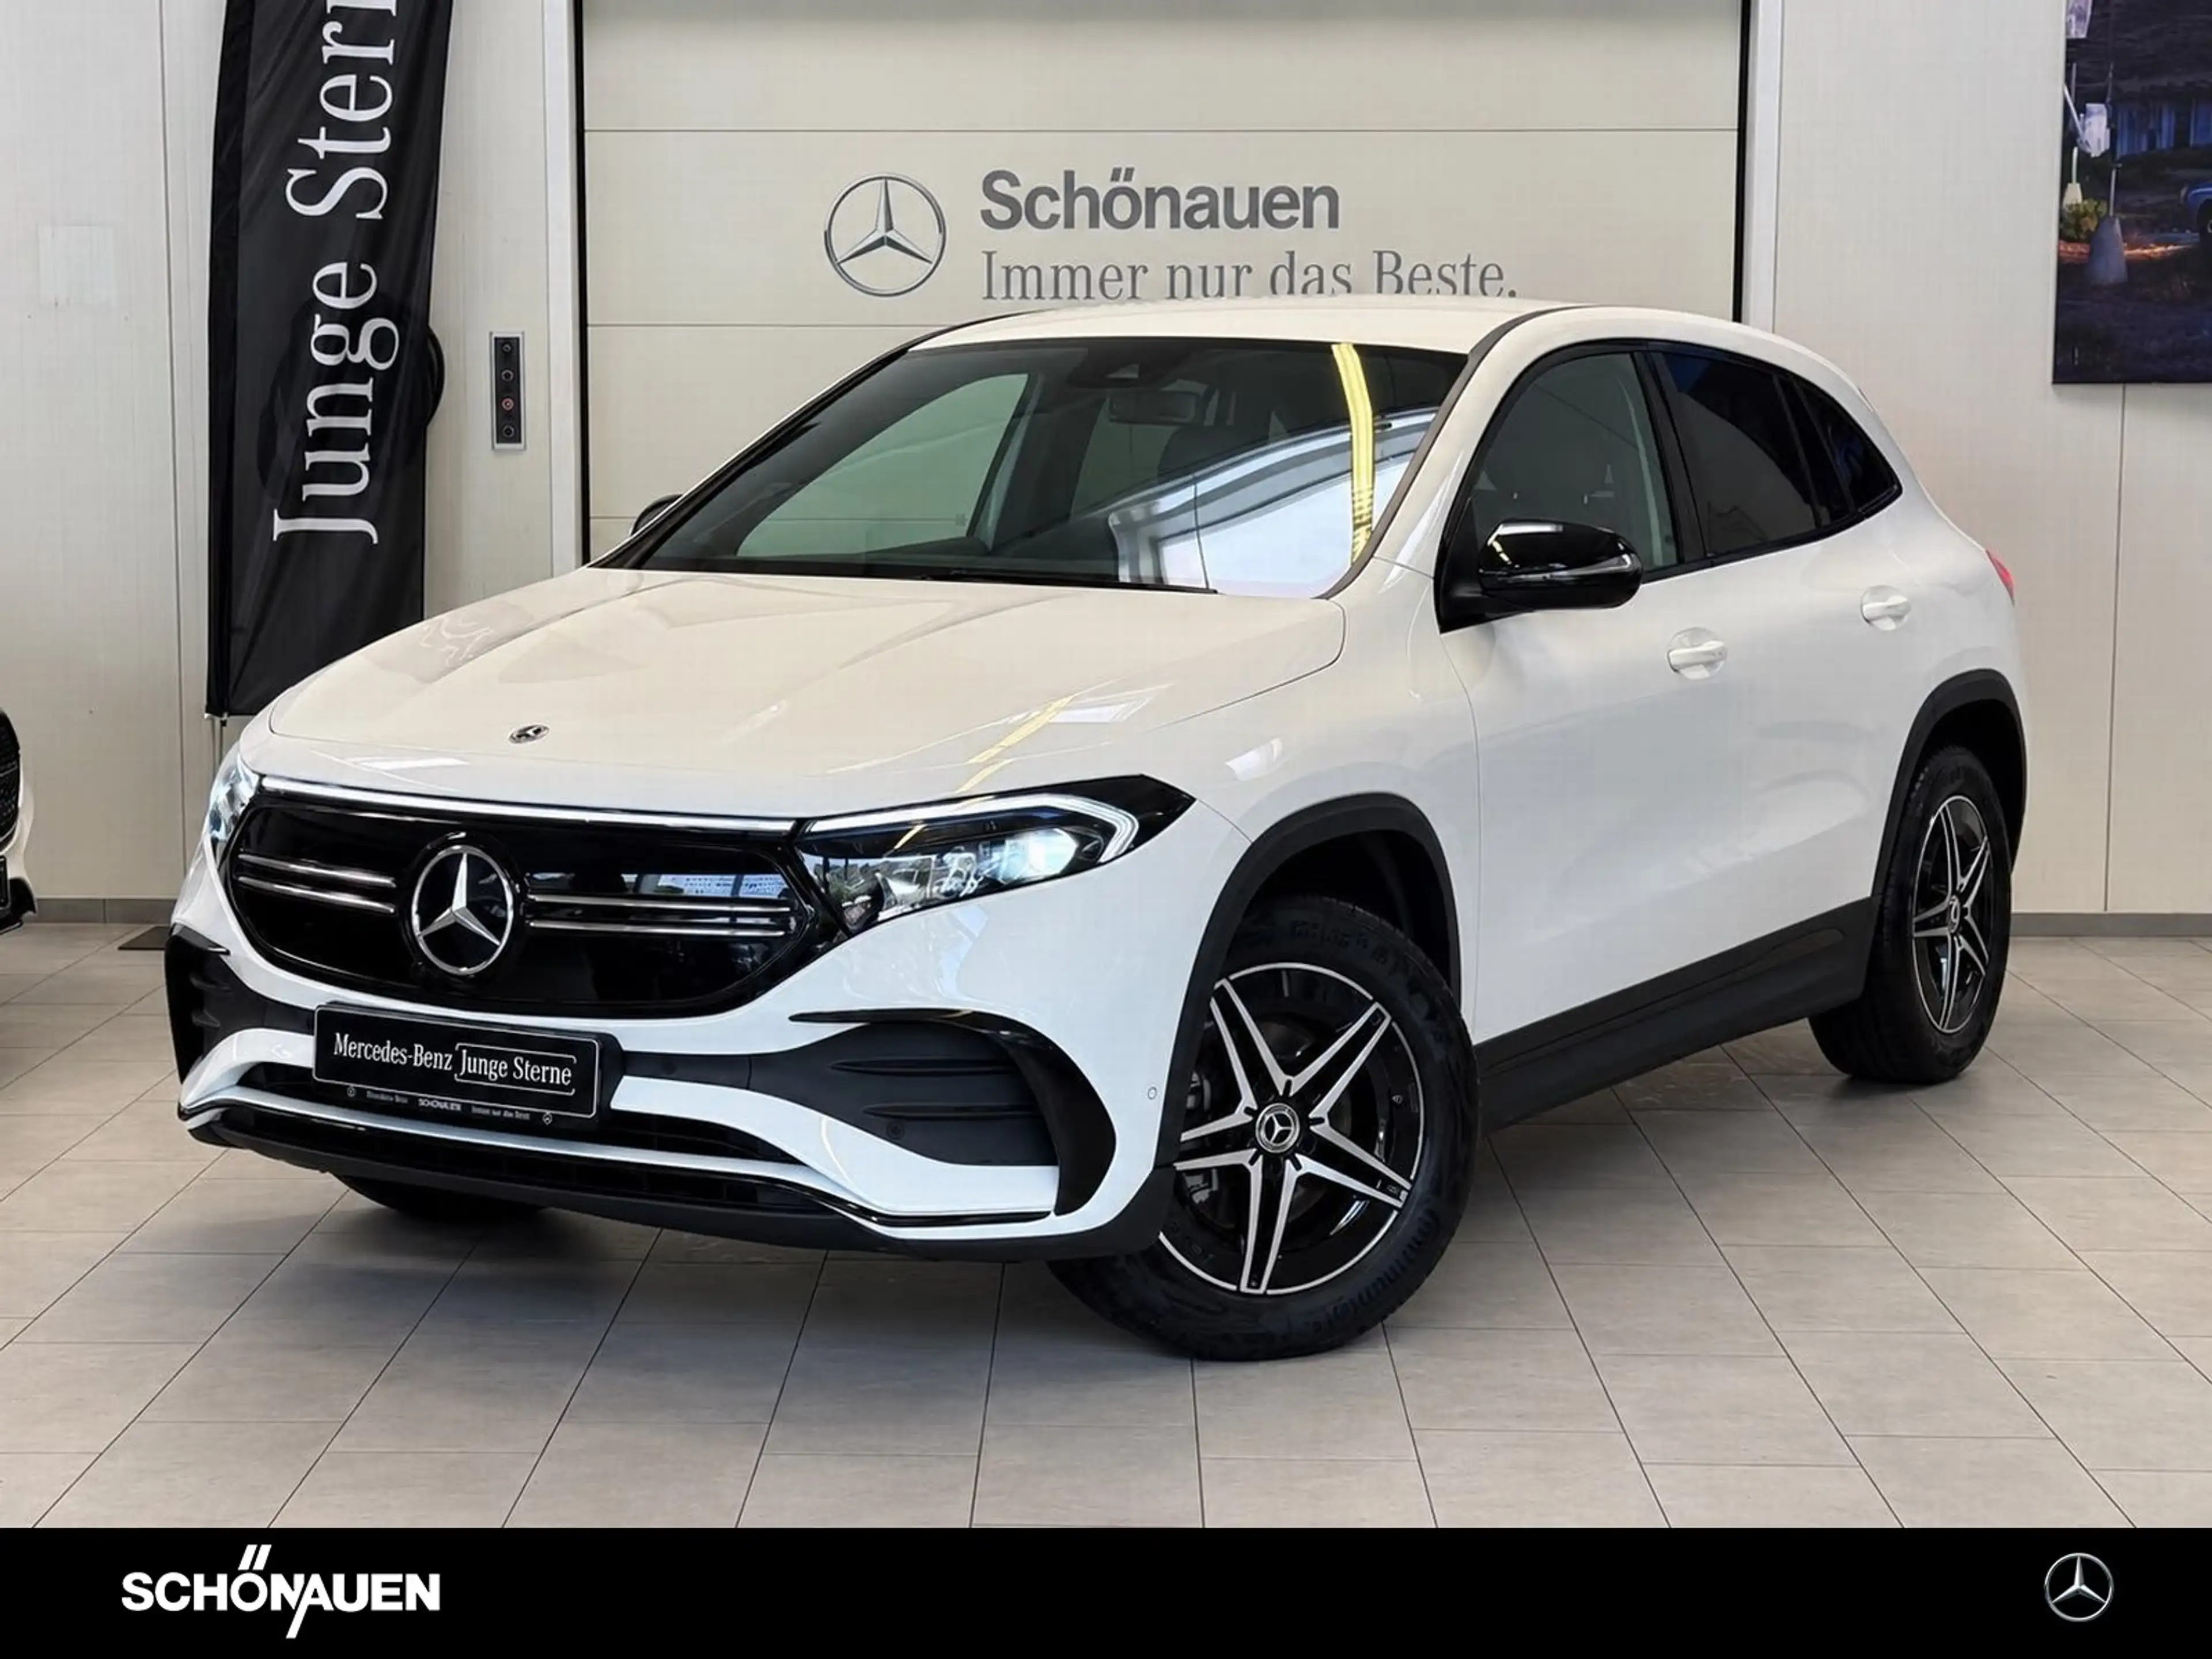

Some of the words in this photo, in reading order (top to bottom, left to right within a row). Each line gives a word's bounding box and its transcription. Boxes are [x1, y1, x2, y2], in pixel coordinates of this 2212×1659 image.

[980, 167, 1339, 230] Schönauen
[983, 251, 1149, 300] Immer
[1167, 264, 1252, 298] nur
[1270, 251, 1353, 296] das
[1372, 251, 1517, 298] Beste.
[273, 262, 399, 544] Junge
[334, 1032, 453, 1071] Mercedes-Benz
[460, 1048, 508, 1081] Junge
[513, 1056, 572, 1086] Sterne
